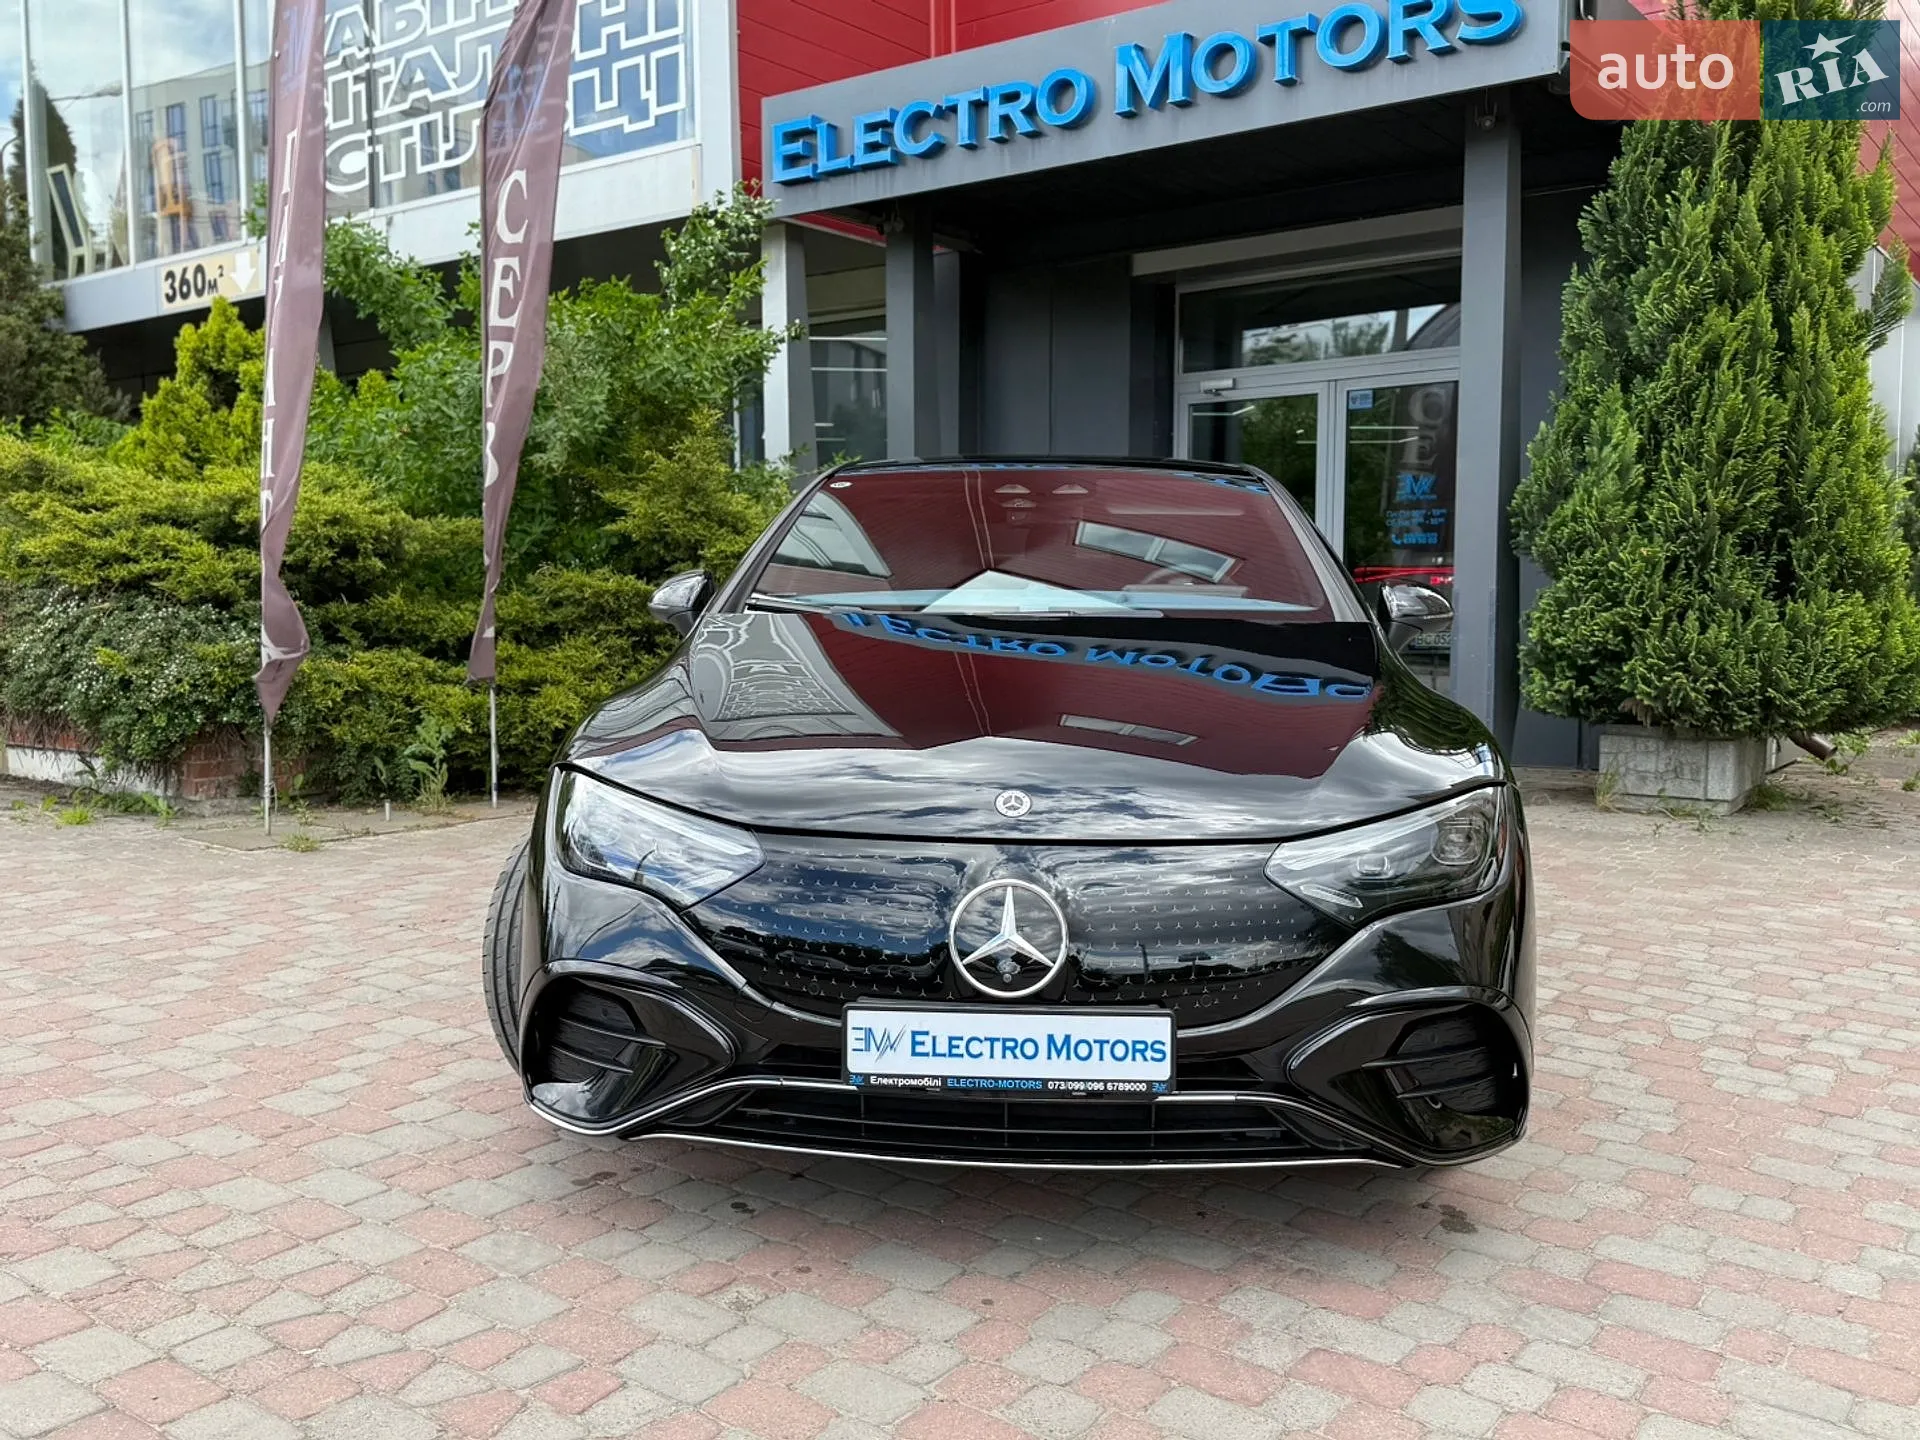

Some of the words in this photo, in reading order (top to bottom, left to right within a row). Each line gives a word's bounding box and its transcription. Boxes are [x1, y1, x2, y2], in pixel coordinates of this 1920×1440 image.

[325, 43, 687, 192] СТІЛЦІ
[770, 69, 1096, 185] ELECTRO
[1114, 0, 1524, 118] MOTORS
[870, 1075, 942, 1088] Електромобілі
[947, 1077, 1043, 1090] ELECTRO-MOTORS
[1106, 1081, 1147, 1092] 6789000
[910, 1030, 1040, 1061] ELECTRO
[1046, 1034, 1168, 1063] MOTORS
